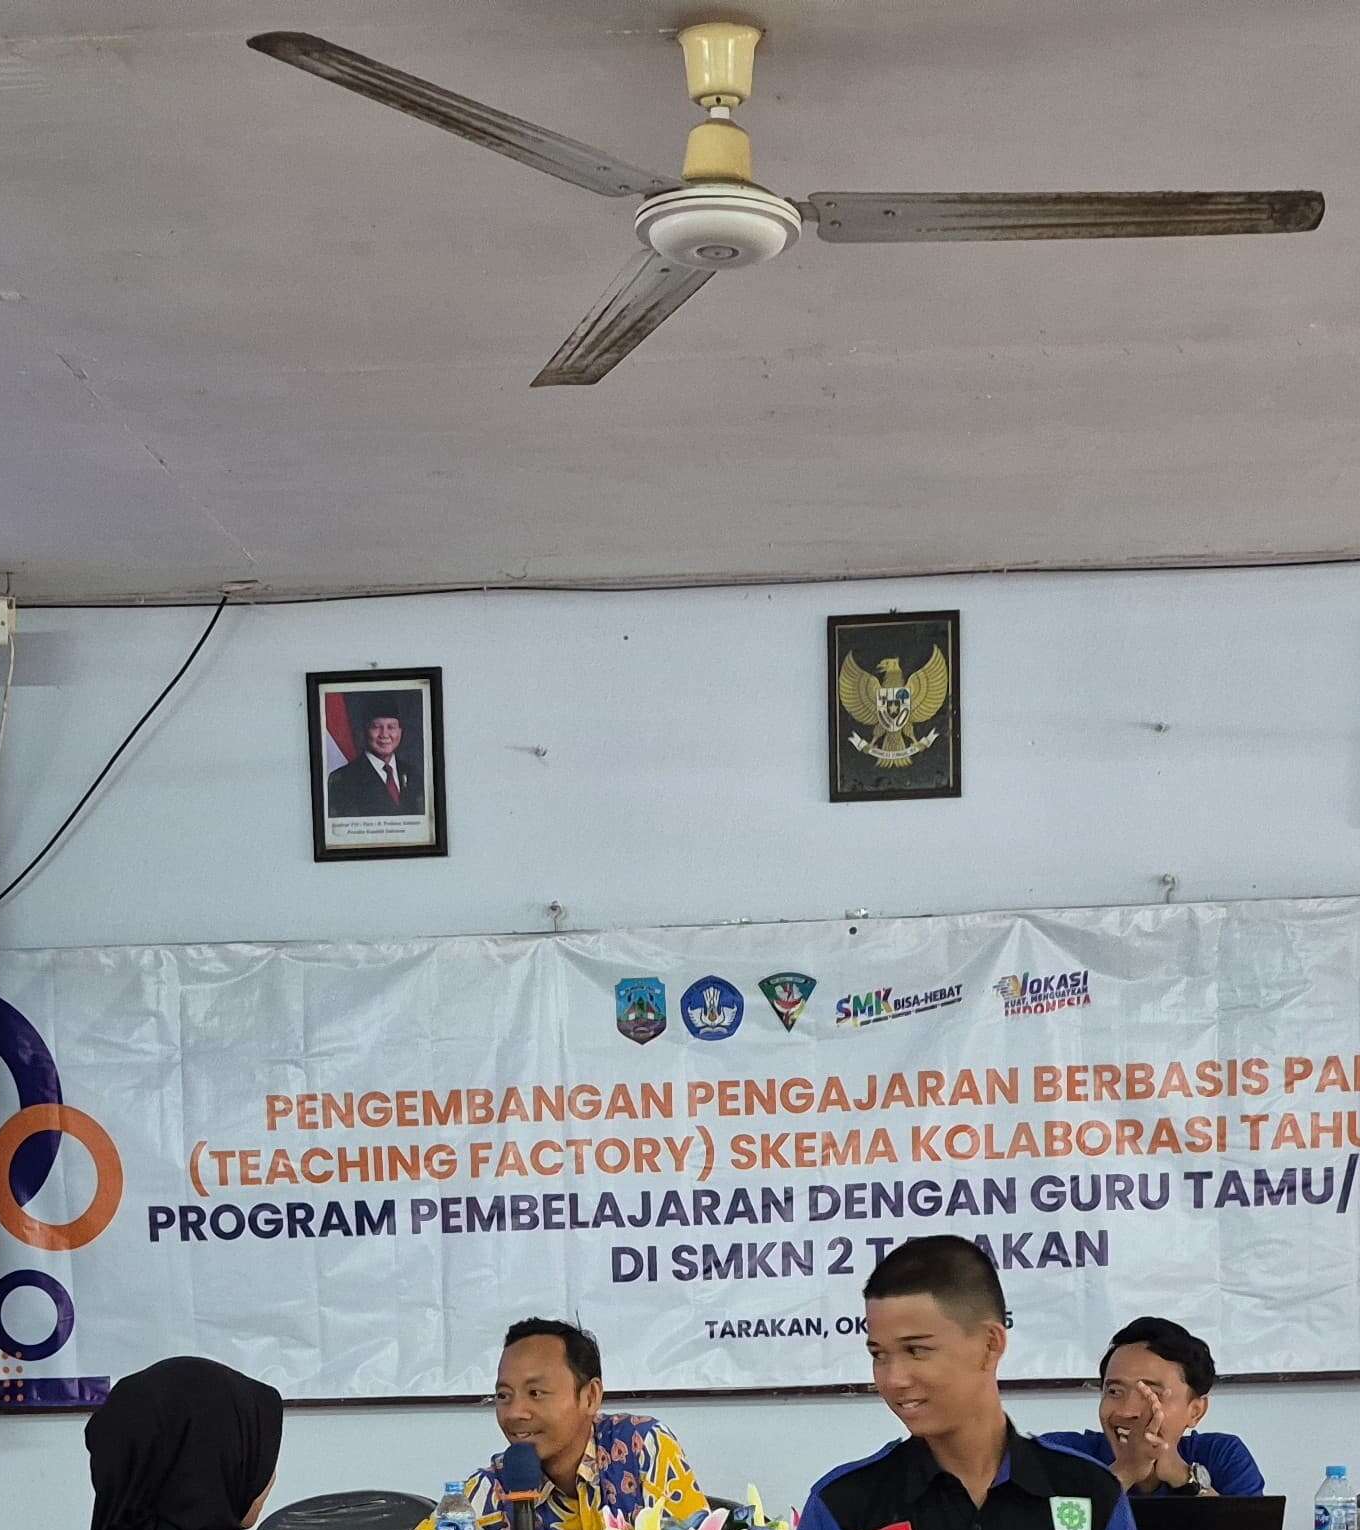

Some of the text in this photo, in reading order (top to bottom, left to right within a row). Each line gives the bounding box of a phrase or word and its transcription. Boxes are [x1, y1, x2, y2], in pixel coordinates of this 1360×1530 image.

[836, 987, 892, 1021] SMK
[894, 984, 963, 1011] BISA-HEBAT
[266, 1084, 674, 1131] PENGEMBANGAN
[687, 1071, 1019, 1117] PENGAJARAN
[1034, 1061, 1270, 1104] BERBASIS
[190, 1144, 458, 1196] (TEACHING
[470, 1128, 715, 1180] FACTORY)
[730, 1129, 897, 1171] SKEMA
[911, 1117, 1228, 1164] KOLABORASI
[148, 1199, 397, 1243] PROGRAM
[410, 1187, 794, 1235] PEMBELAJARAN
[808, 1178, 1017, 1222] DENGAN
[1030, 1173, 1170, 1213] GURU
[611, 1230, 1109, 1283] DI SMKN 2 TAKAN
[705, 1317, 829, 1338] TARAKAN,
